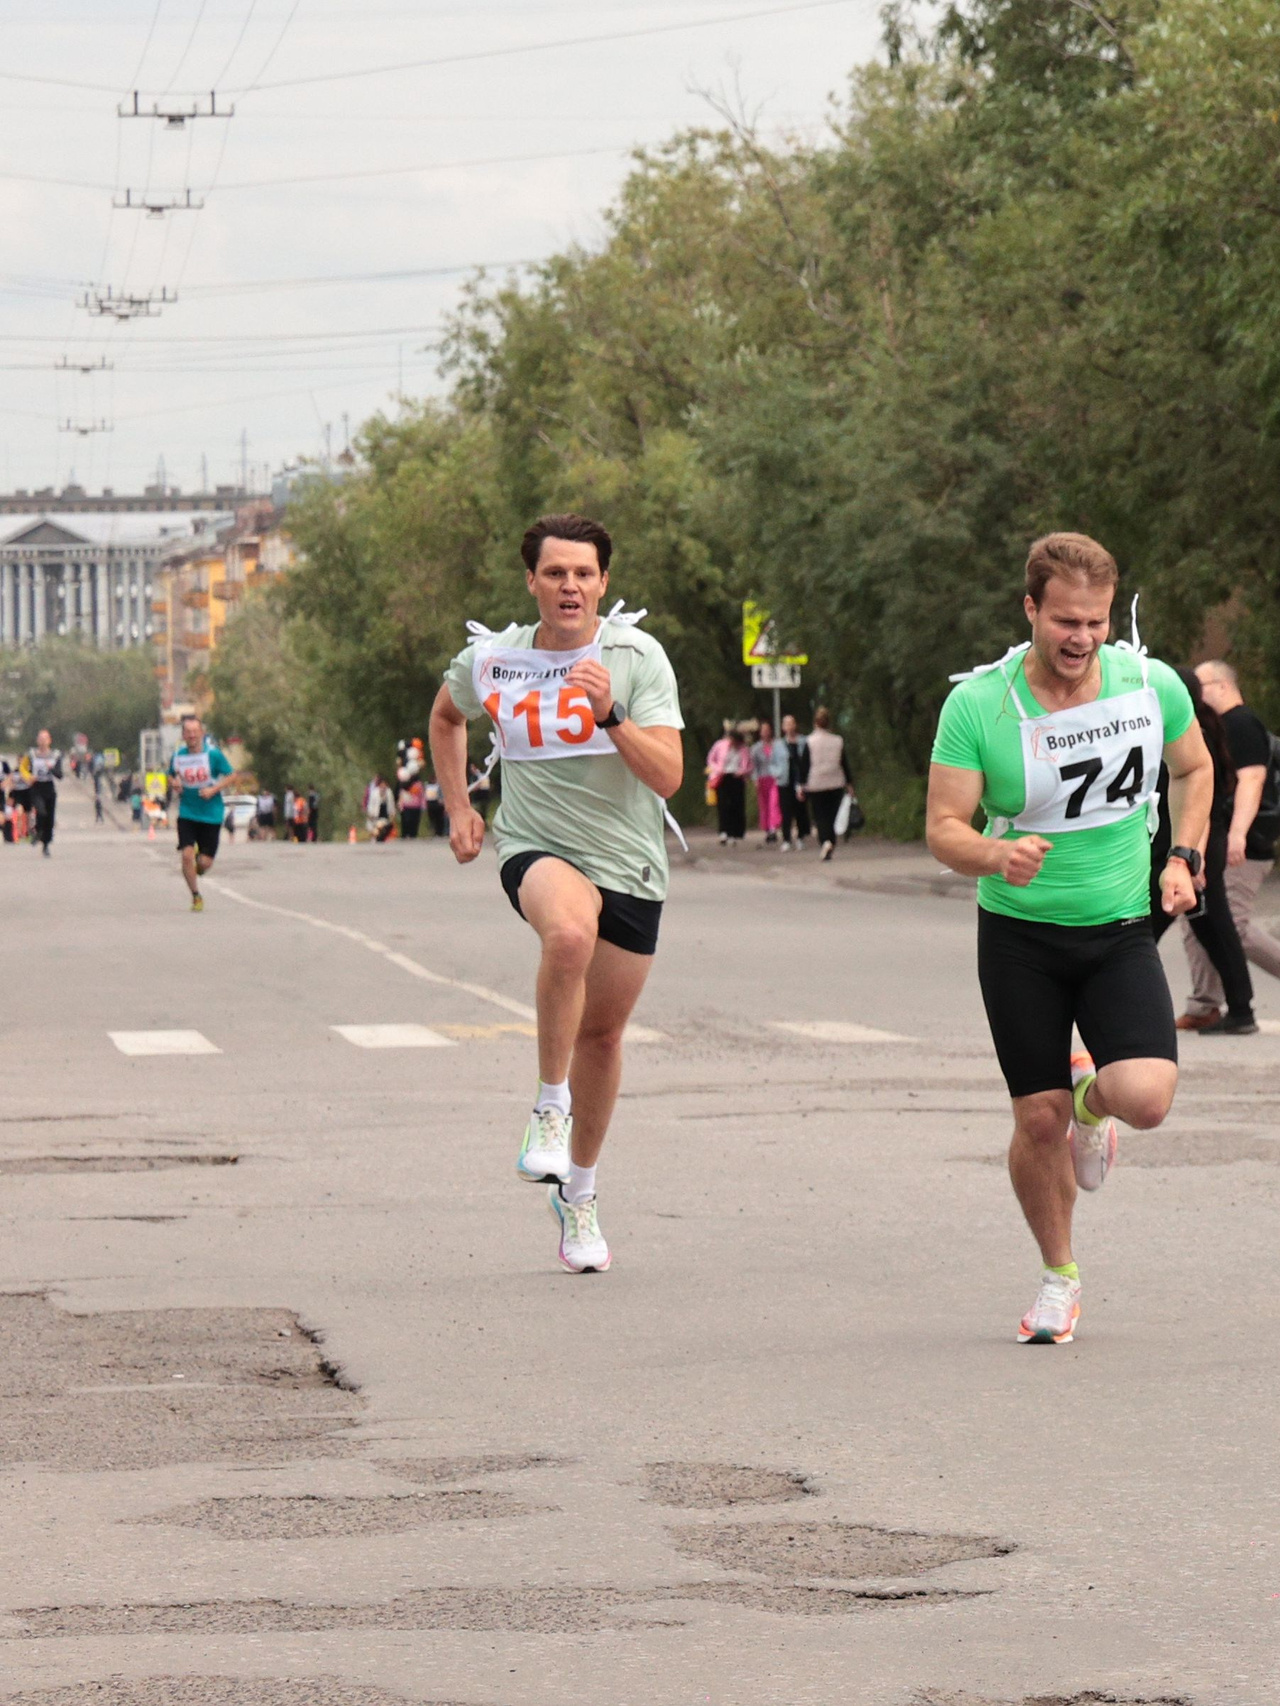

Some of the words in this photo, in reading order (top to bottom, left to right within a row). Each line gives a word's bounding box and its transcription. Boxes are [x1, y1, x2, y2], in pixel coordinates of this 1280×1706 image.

[483, 685, 595, 749] 115
[1046, 715, 1152, 751] ВоркутаУголь
[1058, 745, 1145, 820] 74
